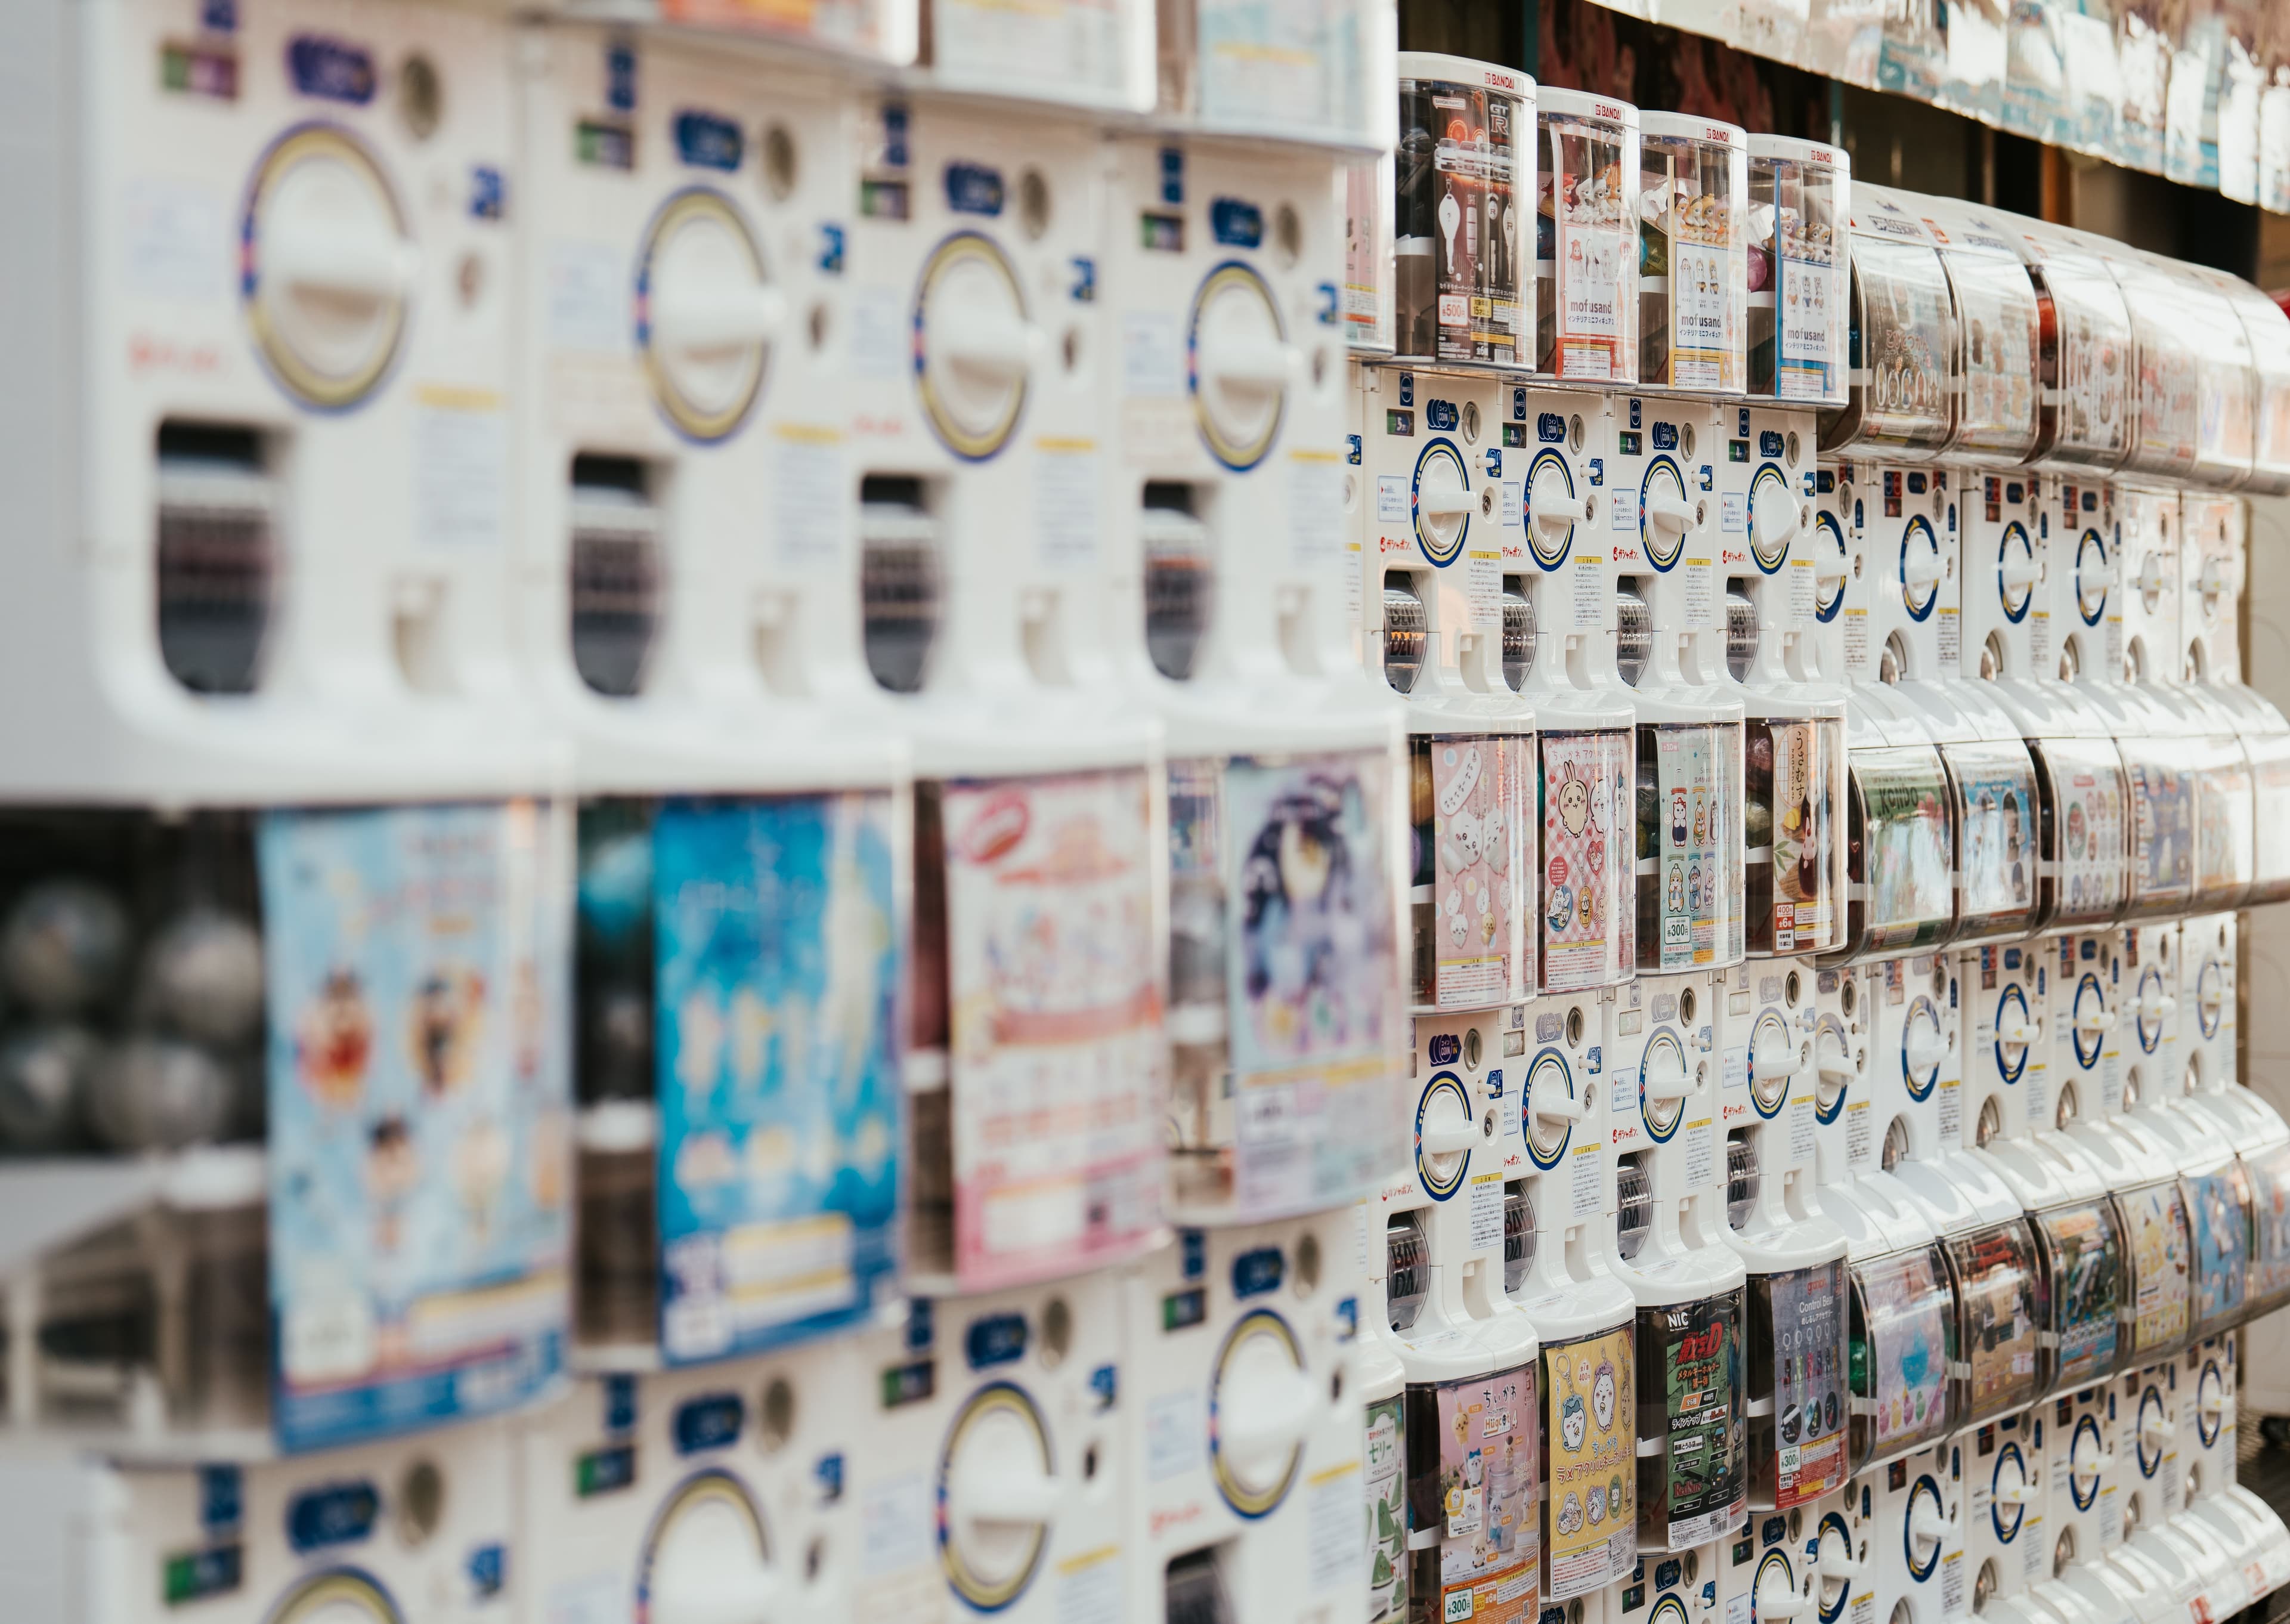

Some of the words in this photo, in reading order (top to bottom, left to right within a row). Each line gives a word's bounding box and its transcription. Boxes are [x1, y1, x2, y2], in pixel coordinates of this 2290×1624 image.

[1492, 74, 1514, 89] BANDAI
[1602, 106, 1622, 121] BANDAI
[1712, 129, 1729, 143] BANDA
[1816, 151, 1833, 165] BANDA
[1571, 299, 1613, 314] mofusand
[1681, 314, 1721, 328] mofusand
[1788, 328, 1825, 342] mofusand
[1796, 731, 1804, 800] うさむす
[1799, 1298, 1822, 1313] Control
[1822, 1295, 1833, 1307] Bear
[1667, 1312, 1689, 1328] NIC
[1677, 1361, 1720, 1381] メタルキーホルダー
[1483, 1382, 1517, 1408] ちいかわ
[1672, 1412, 1701, 1430] ラインナップ
[1592, 1436, 1618, 1458] ちいかわ
